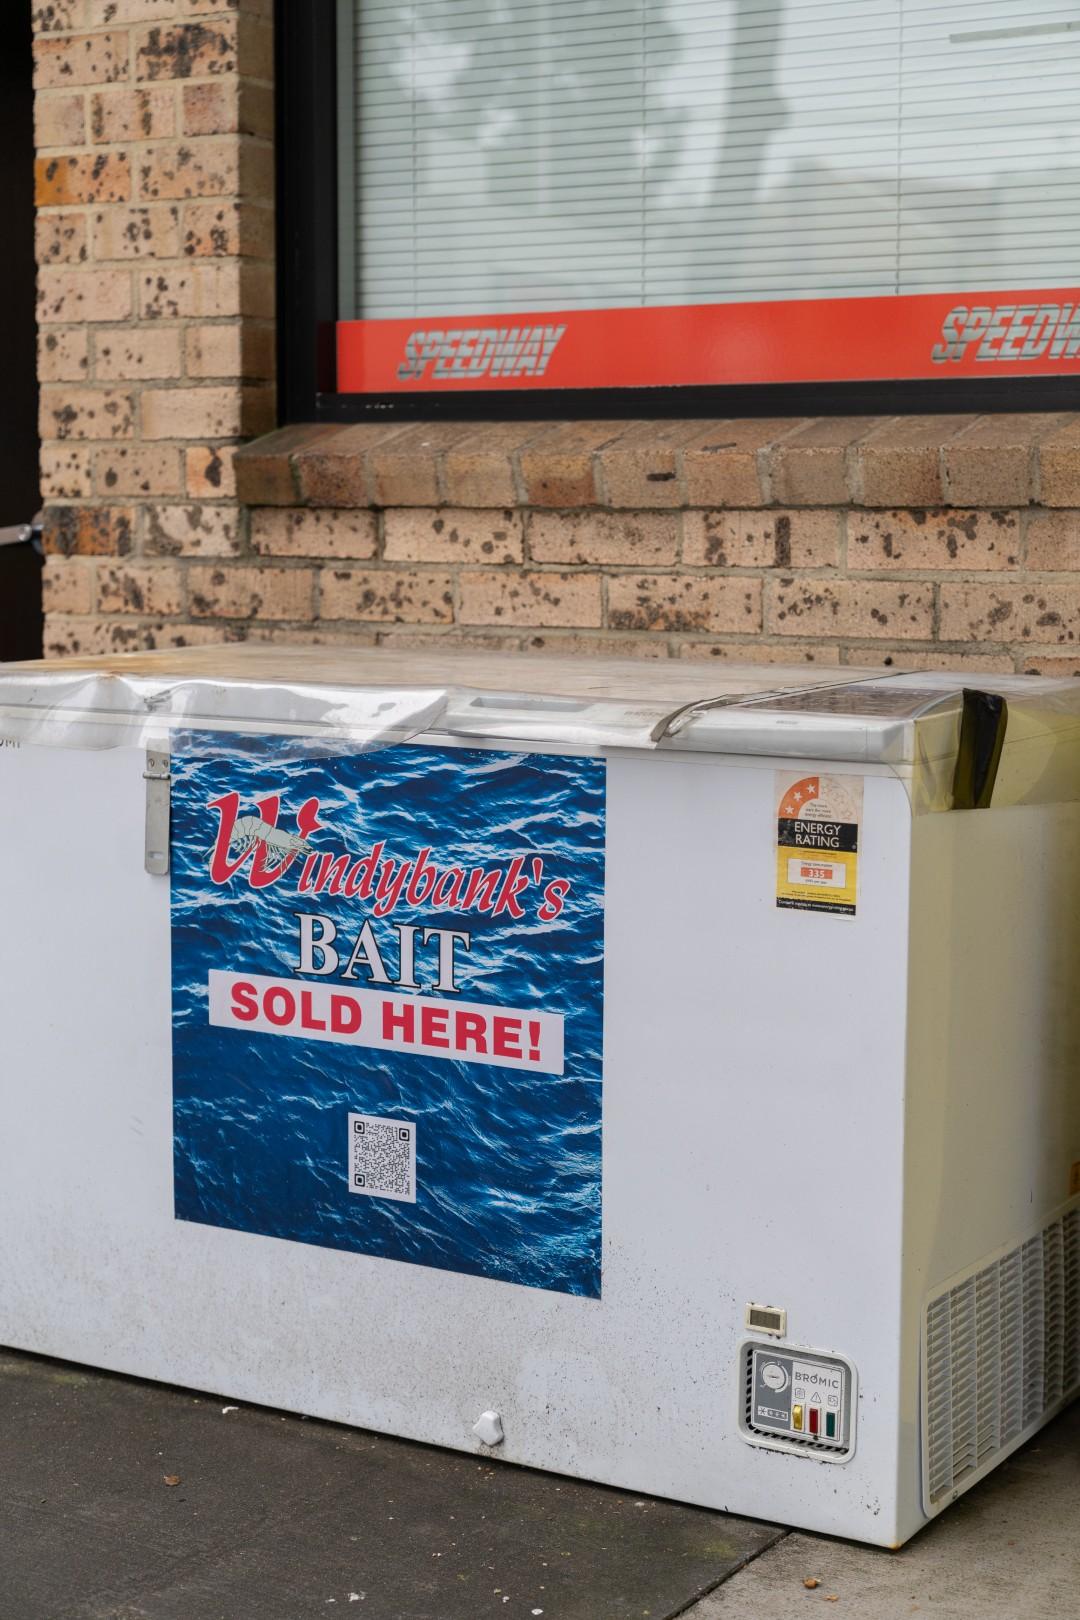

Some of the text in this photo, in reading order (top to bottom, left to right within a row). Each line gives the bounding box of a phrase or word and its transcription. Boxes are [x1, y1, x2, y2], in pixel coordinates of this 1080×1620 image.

[396, 324, 568, 381] SPEEDWAY
[206, 792, 571, 921] Windybank's
[794, 821, 841, 836] ENERGY
[795, 833, 840, 848] RATING
[294, 912, 471, 994] BAIT
[231, 982, 541, 1062] SOLD HERE!
[795, 1371, 839, 1388] BROMIC
